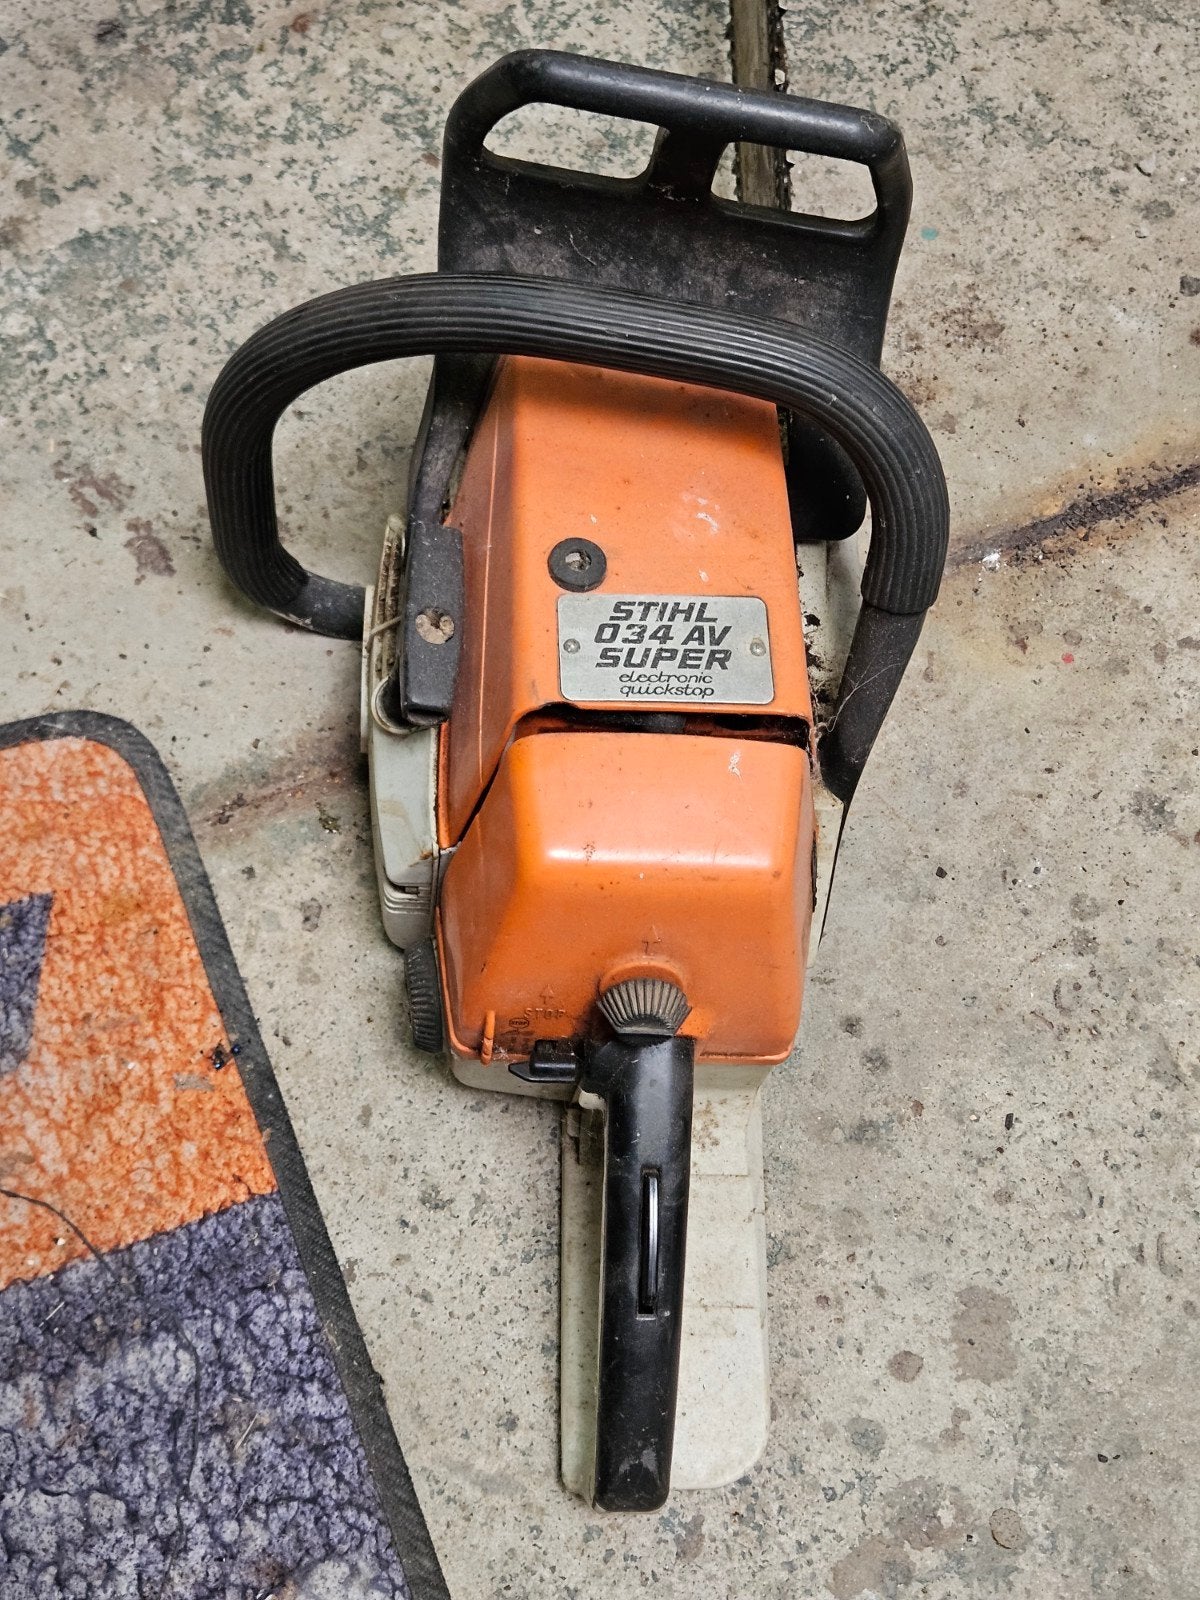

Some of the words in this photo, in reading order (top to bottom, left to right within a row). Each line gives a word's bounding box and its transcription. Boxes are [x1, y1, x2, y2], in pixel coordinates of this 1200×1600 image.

[609, 601, 718, 622] STIHL
[594, 623, 674, 645] 034
[681, 625, 733, 646] AV
[595, 647, 733, 670] SUPER
[618, 671, 713, 684] electronic
[620, 684, 715, 699] quickstop
